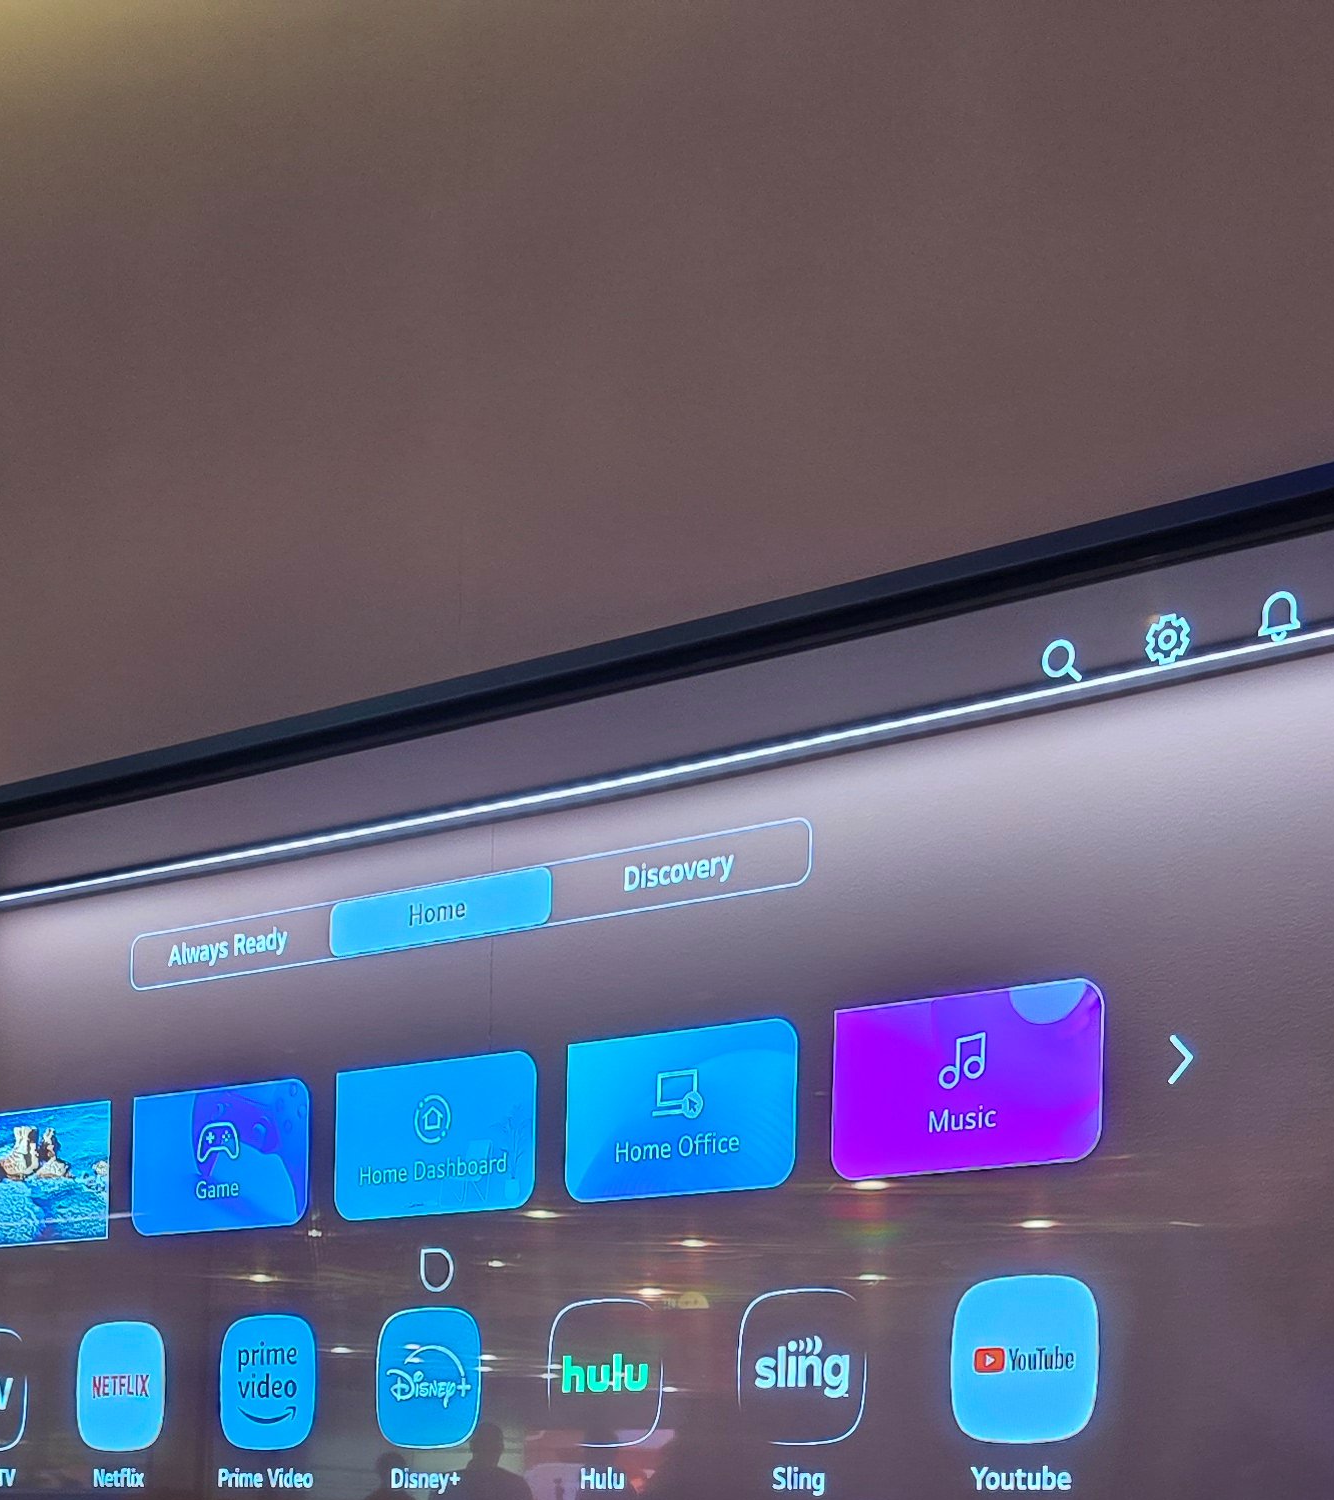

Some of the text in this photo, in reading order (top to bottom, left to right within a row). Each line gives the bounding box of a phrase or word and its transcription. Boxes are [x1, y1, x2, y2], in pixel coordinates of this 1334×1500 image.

[622, 851, 735, 893] Discovery
[408, 899, 466, 928] Home
[167, 928, 288, 968] Always Ready
[927, 1106, 998, 1134] Music
[614, 1132, 741, 1163] Home Office
[358, 1151, 508, 1186] Home Dashboard
[195, 1180, 240, 1200] Game
[237, 1341, 298, 1371] prime
[754, 1335, 850, 1399] sling
[1008, 1346, 1075, 1372] YouTube
[91, 1373, 150, 1399] NETFLIX
[238, 1372, 298, 1400] video
[561, 1353, 649, 1394] hulu
[93, 1467, 145, 1488] Netflix
[217, 1467, 314, 1489] Prime Video
[390, 1468, 461, 1494] Disney+
[580, 1467, 625, 1491] Hulu
[772, 1466, 825, 1496] Sling
[971, 1465, 1072, 1493] Youtube
